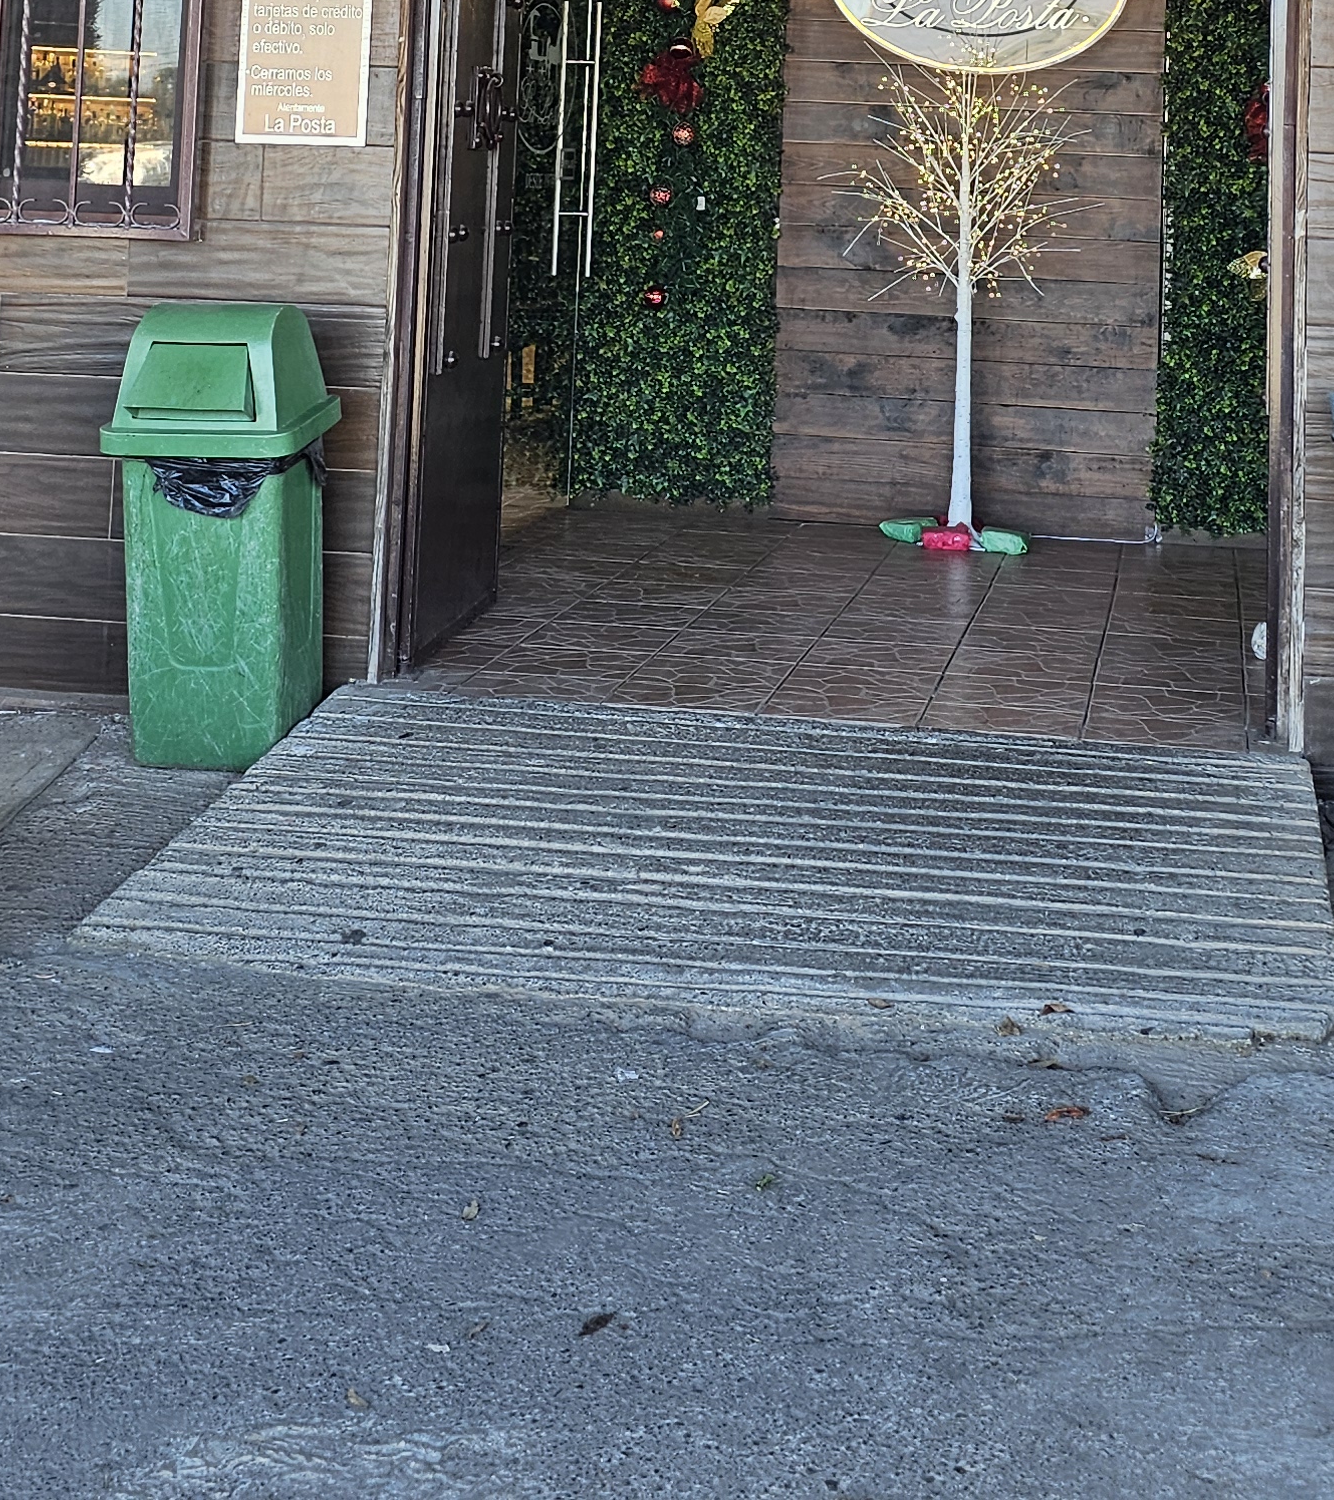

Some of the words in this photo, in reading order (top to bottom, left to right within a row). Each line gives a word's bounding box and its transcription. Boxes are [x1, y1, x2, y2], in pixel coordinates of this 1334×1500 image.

[302, 4, 317, 17] de
[253, 23, 261, 34] o
[309, 22, 335, 35] solo
[251, 65, 310, 80] Cerramos
[314, 67, 332, 81] los
[264, 114, 284, 132] La
[289, 115, 335, 134] Posta
